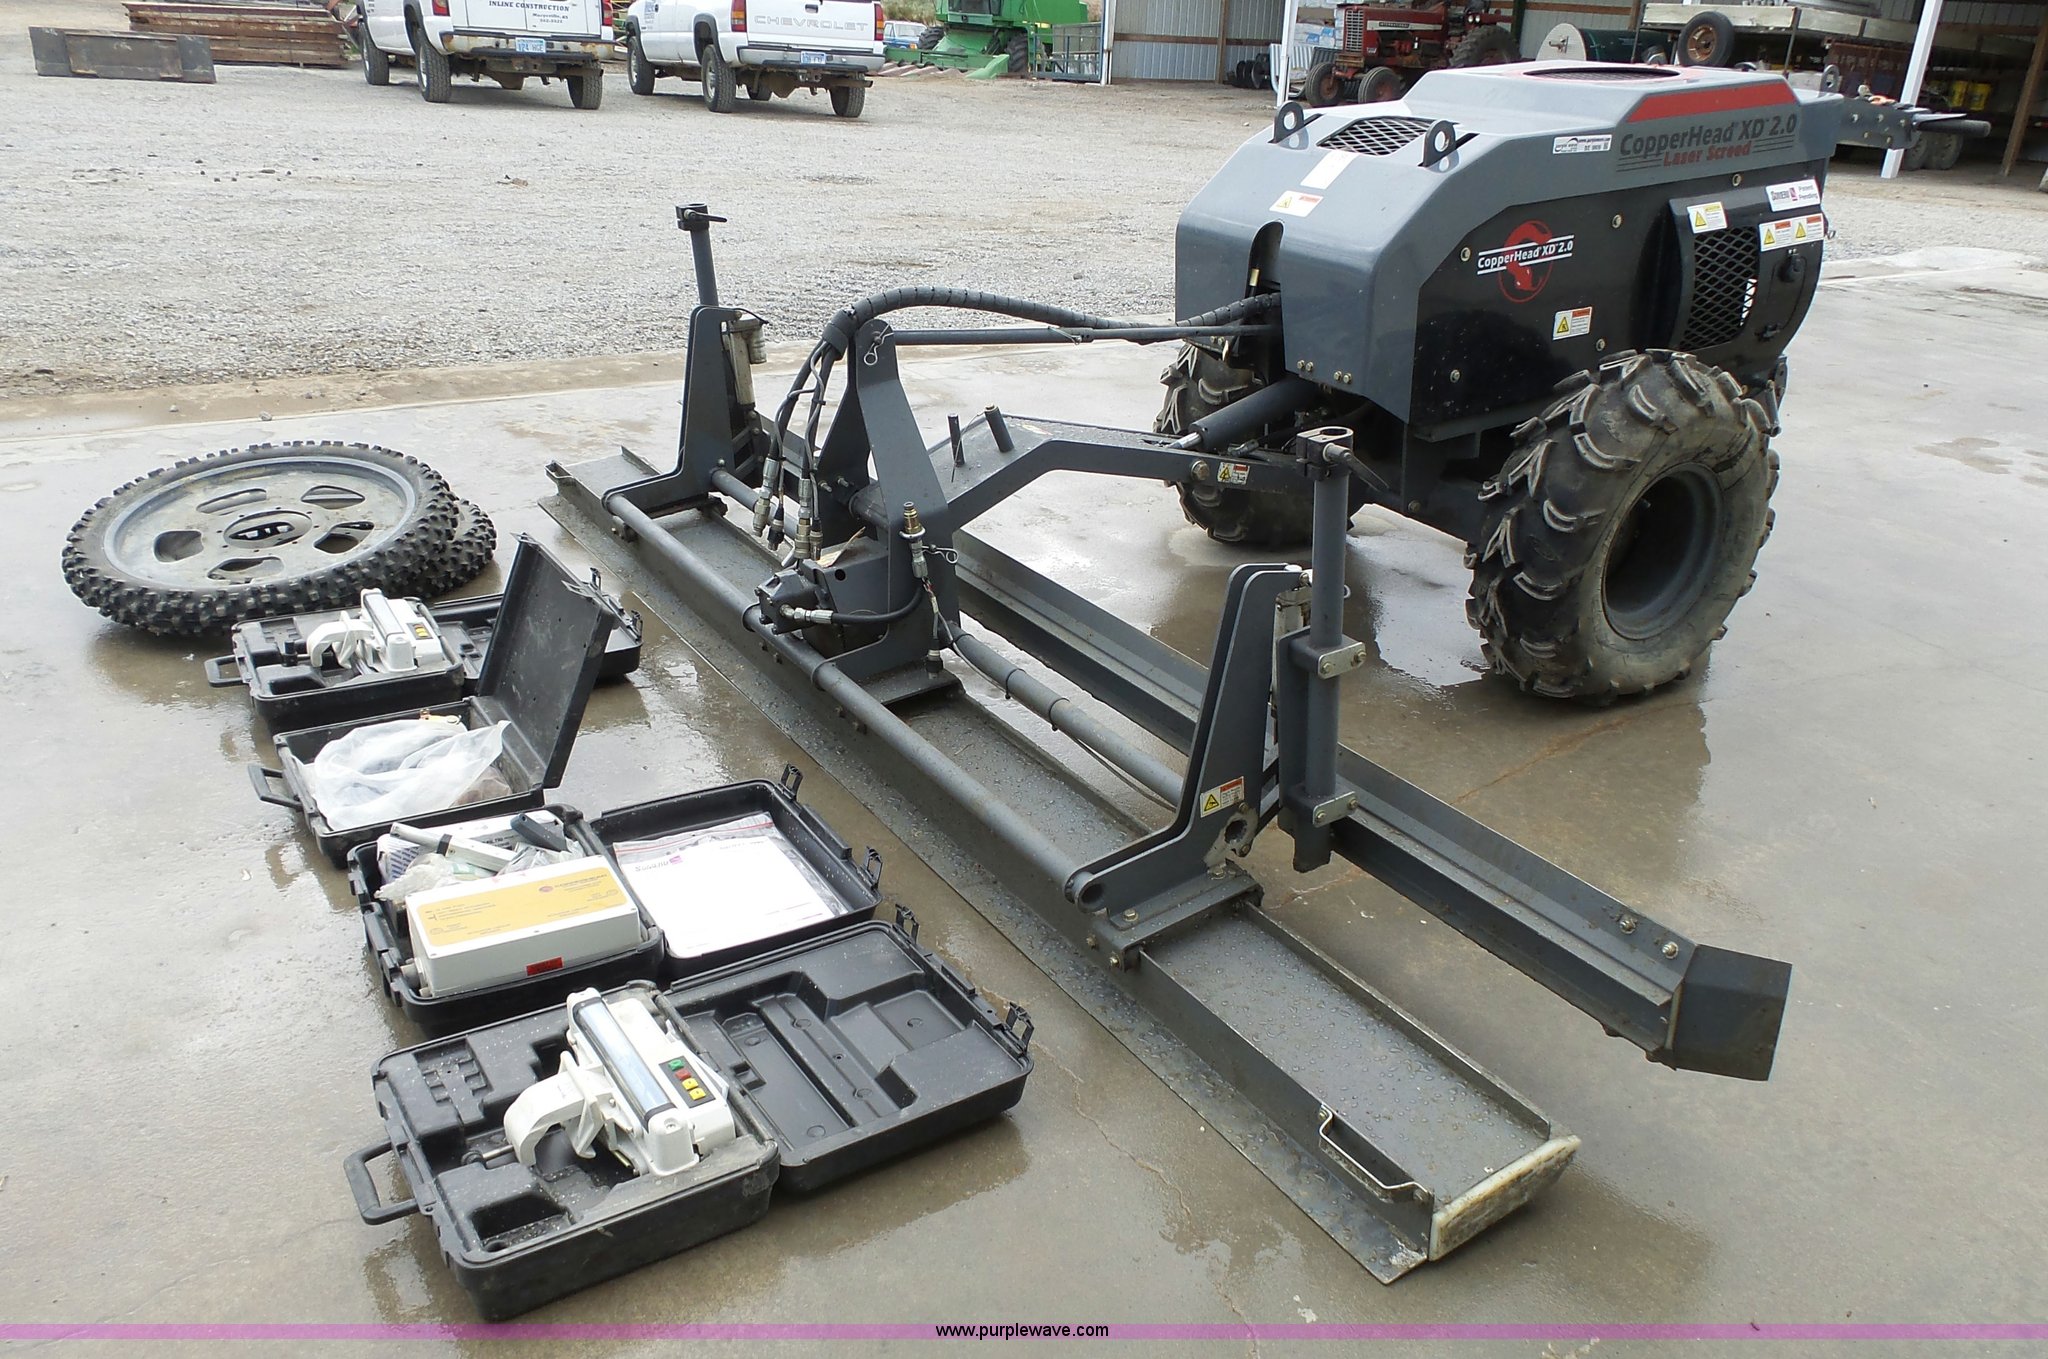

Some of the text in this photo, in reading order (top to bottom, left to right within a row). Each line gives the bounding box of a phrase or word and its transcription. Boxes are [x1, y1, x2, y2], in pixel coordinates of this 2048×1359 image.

[489, 0, 570, 12] INLINE CONSTRUCTION
[754, 15, 868, 31] CHEVROLET
[1619, 123, 1735, 158] CopperHead
[1769, 113, 1797, 136] 2.0
[1663, 142, 1751, 167] Laser Screed
[1477, 247, 1540, 270] CopperHead
[1558, 240, 1574, 252] 2.0
